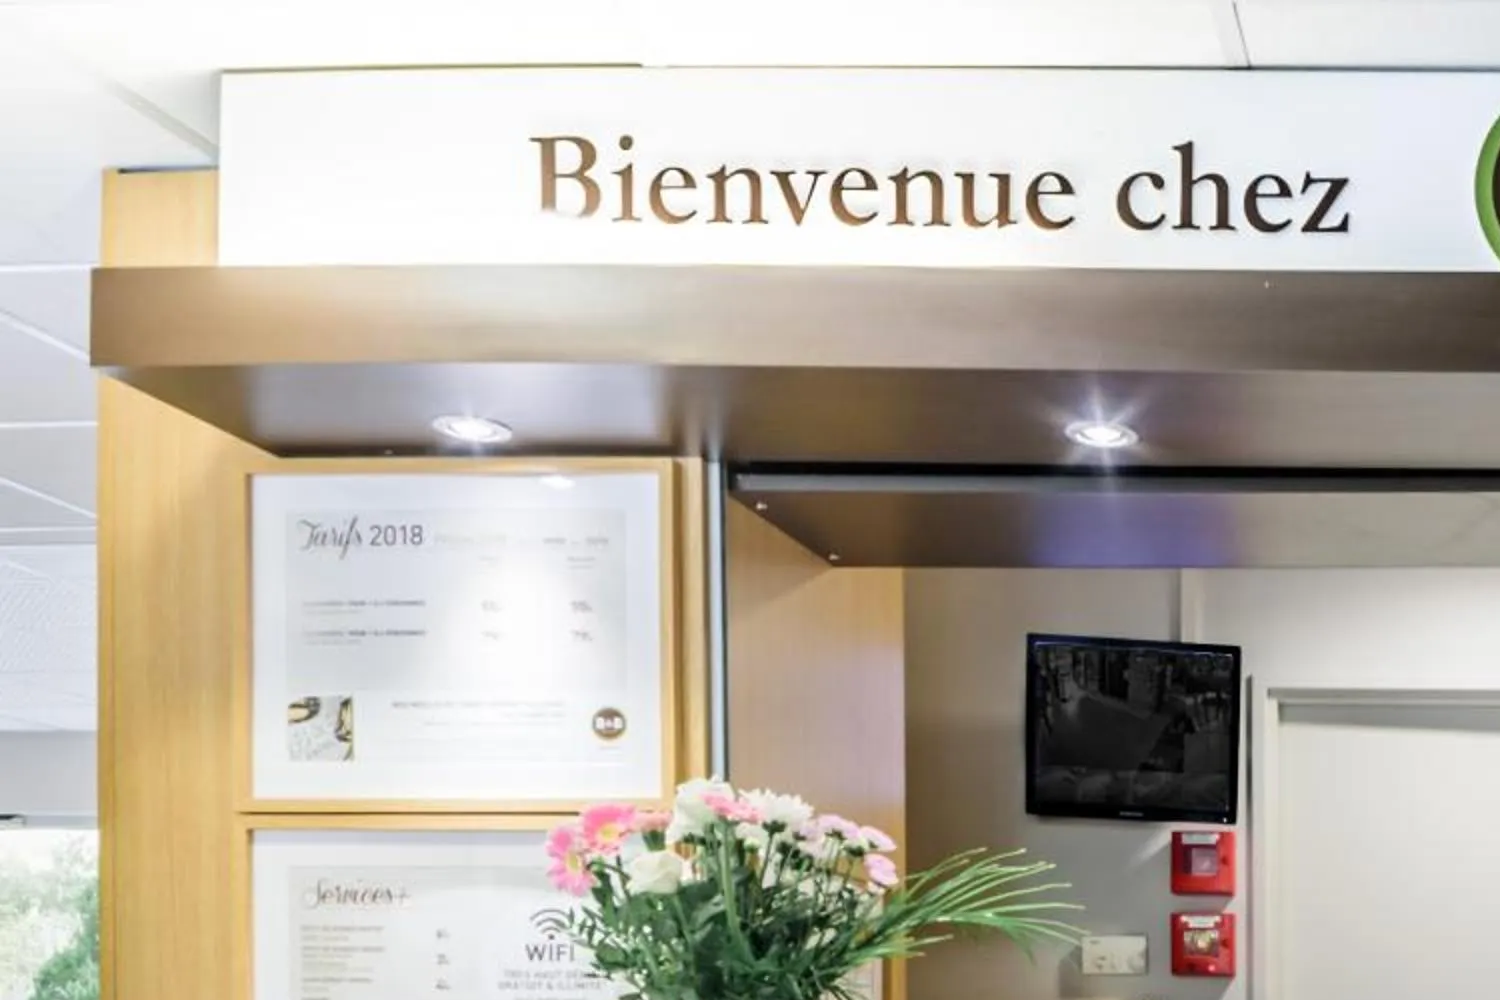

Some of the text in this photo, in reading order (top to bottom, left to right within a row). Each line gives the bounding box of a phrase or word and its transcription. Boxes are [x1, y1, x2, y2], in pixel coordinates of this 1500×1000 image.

[529, 134, 1351, 235] Bienvenue chez
[297, 515, 423, 560] Tarifs 2018
[525, 943, 575, 961] WIFI
